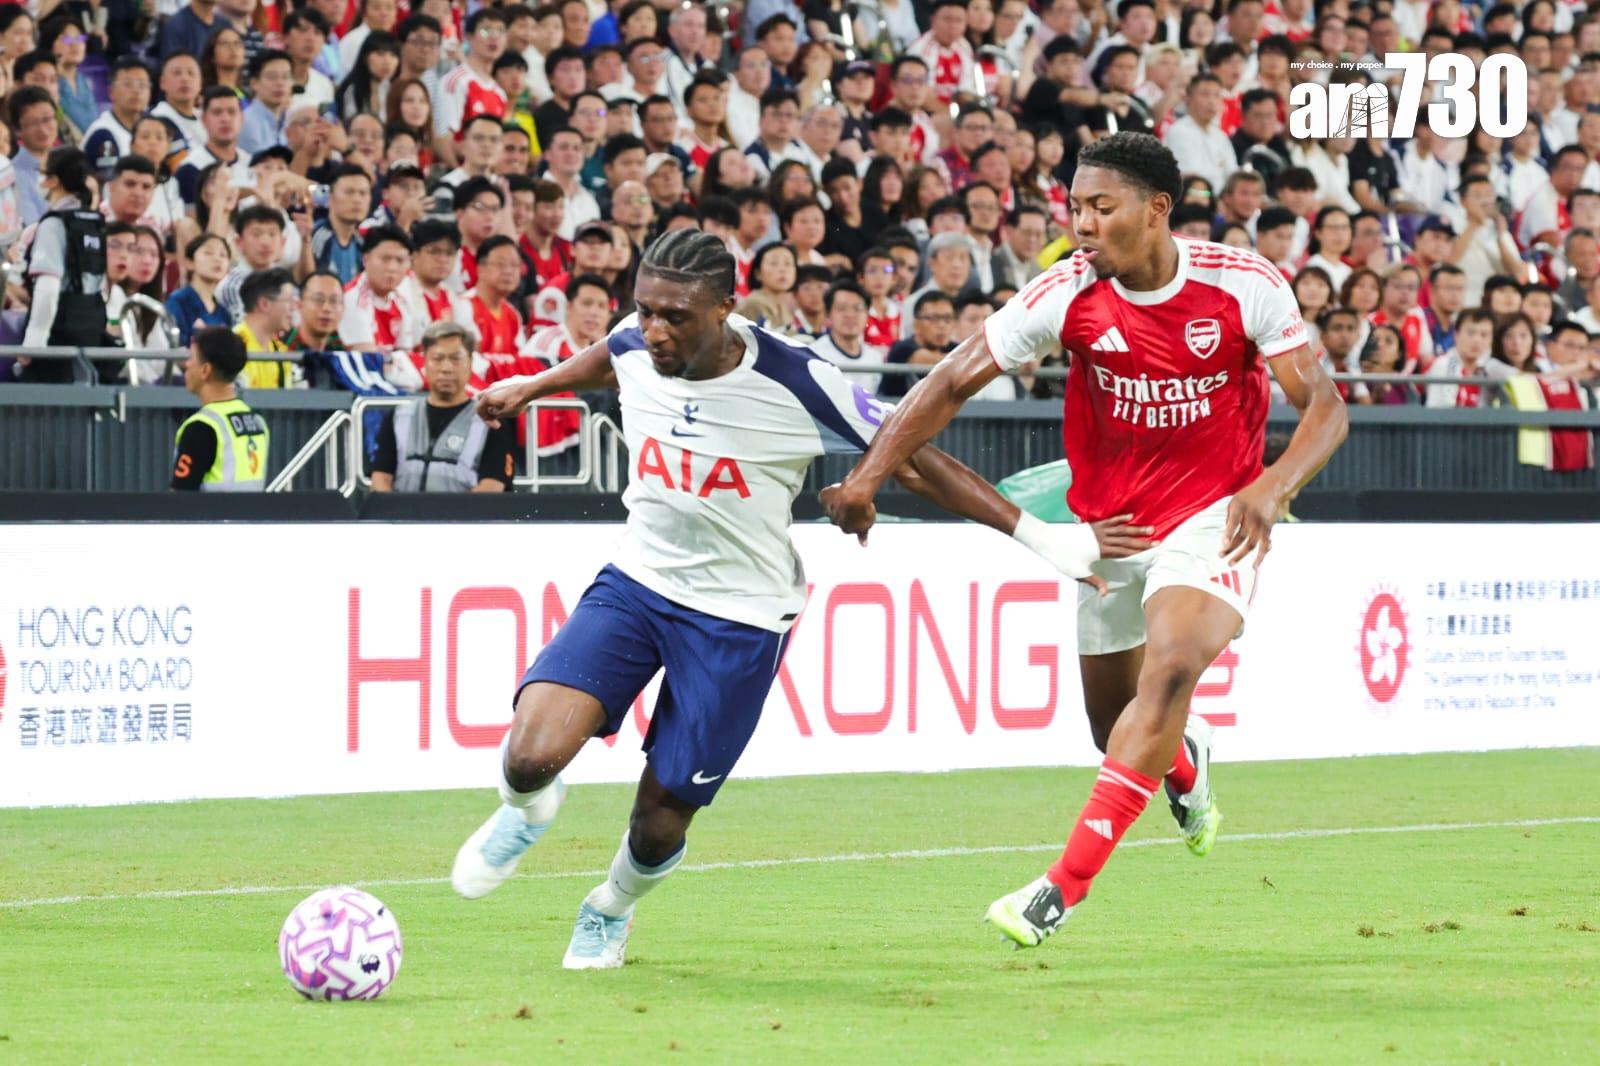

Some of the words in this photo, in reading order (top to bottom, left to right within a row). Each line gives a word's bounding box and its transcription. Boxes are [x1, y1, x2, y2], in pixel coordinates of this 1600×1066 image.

[1092, 364, 1229, 404] Emirates
[1112, 398, 1142, 425] FLY
[637, 436, 752, 499] AIA
[18, 605, 105, 649] HONG
[111, 604, 193, 647] KONG
[19, 658, 113, 695] TOURISM
[119, 656, 193, 692] BOARD
[18, 702, 193, 747] 香港旅遊發展局
